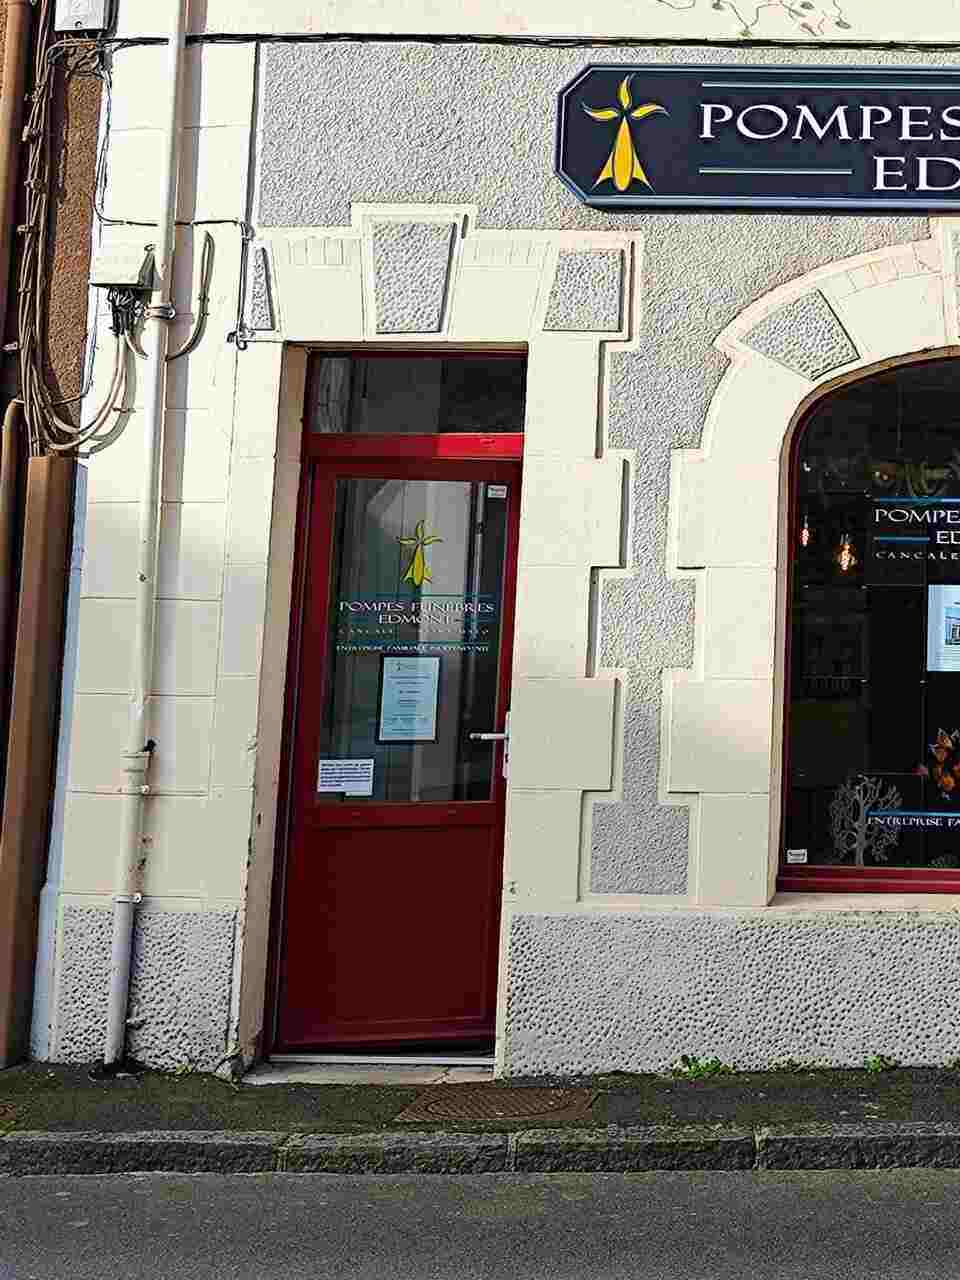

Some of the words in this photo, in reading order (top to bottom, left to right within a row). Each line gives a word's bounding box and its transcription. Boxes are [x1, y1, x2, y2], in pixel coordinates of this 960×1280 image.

[876, 551, 960, 561] CANCALE
[339, 600, 406, 612] POMPES
[378, 613, 455, 625] EDMONT
